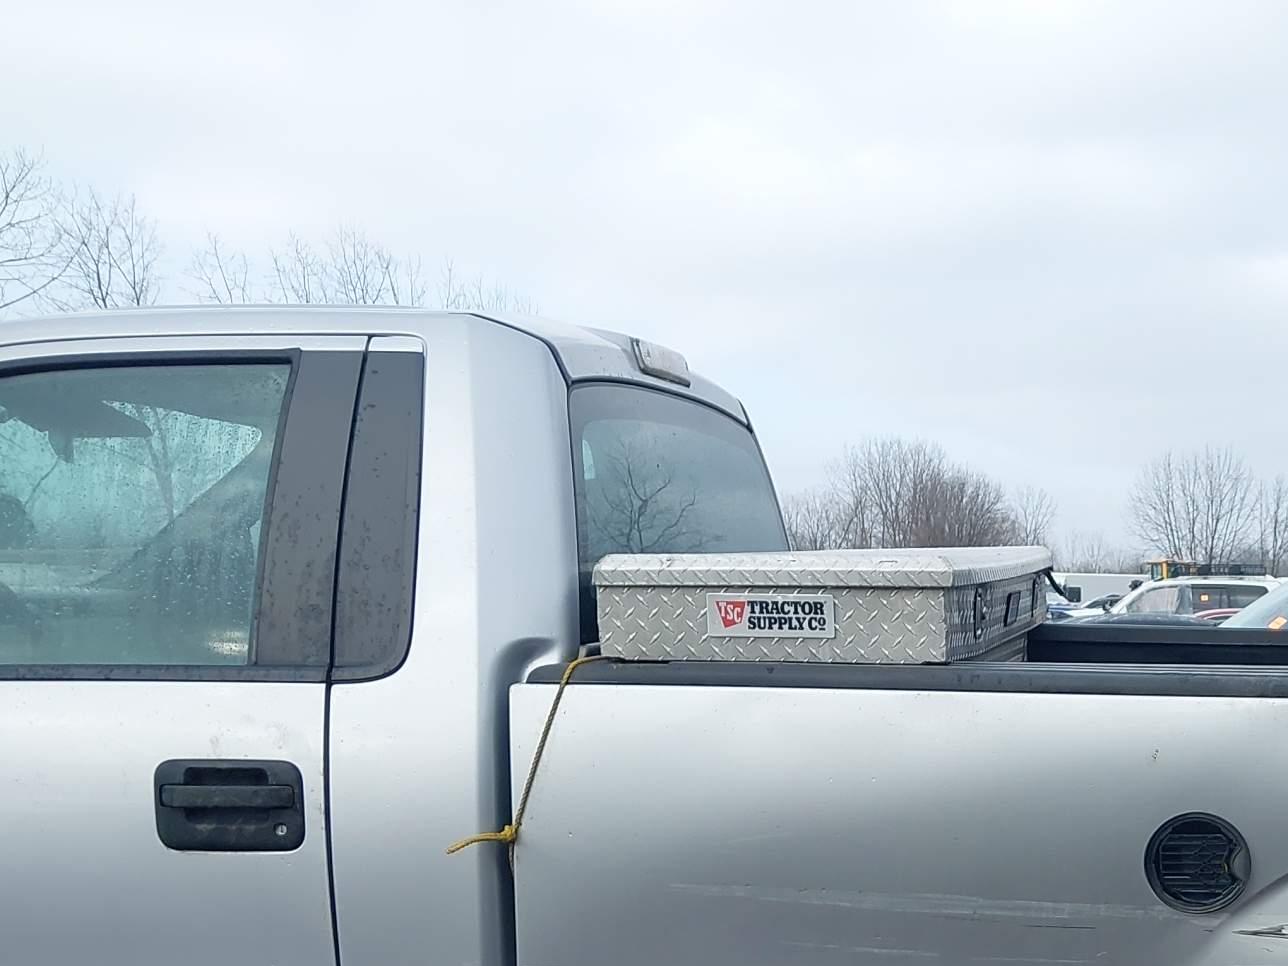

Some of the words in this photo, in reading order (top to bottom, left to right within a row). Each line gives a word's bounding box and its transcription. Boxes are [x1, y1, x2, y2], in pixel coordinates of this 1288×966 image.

[719, 602, 742, 622] TSC
[747, 601, 825, 615] TRACTOR
[748, 616, 804, 631] SUPPLY
